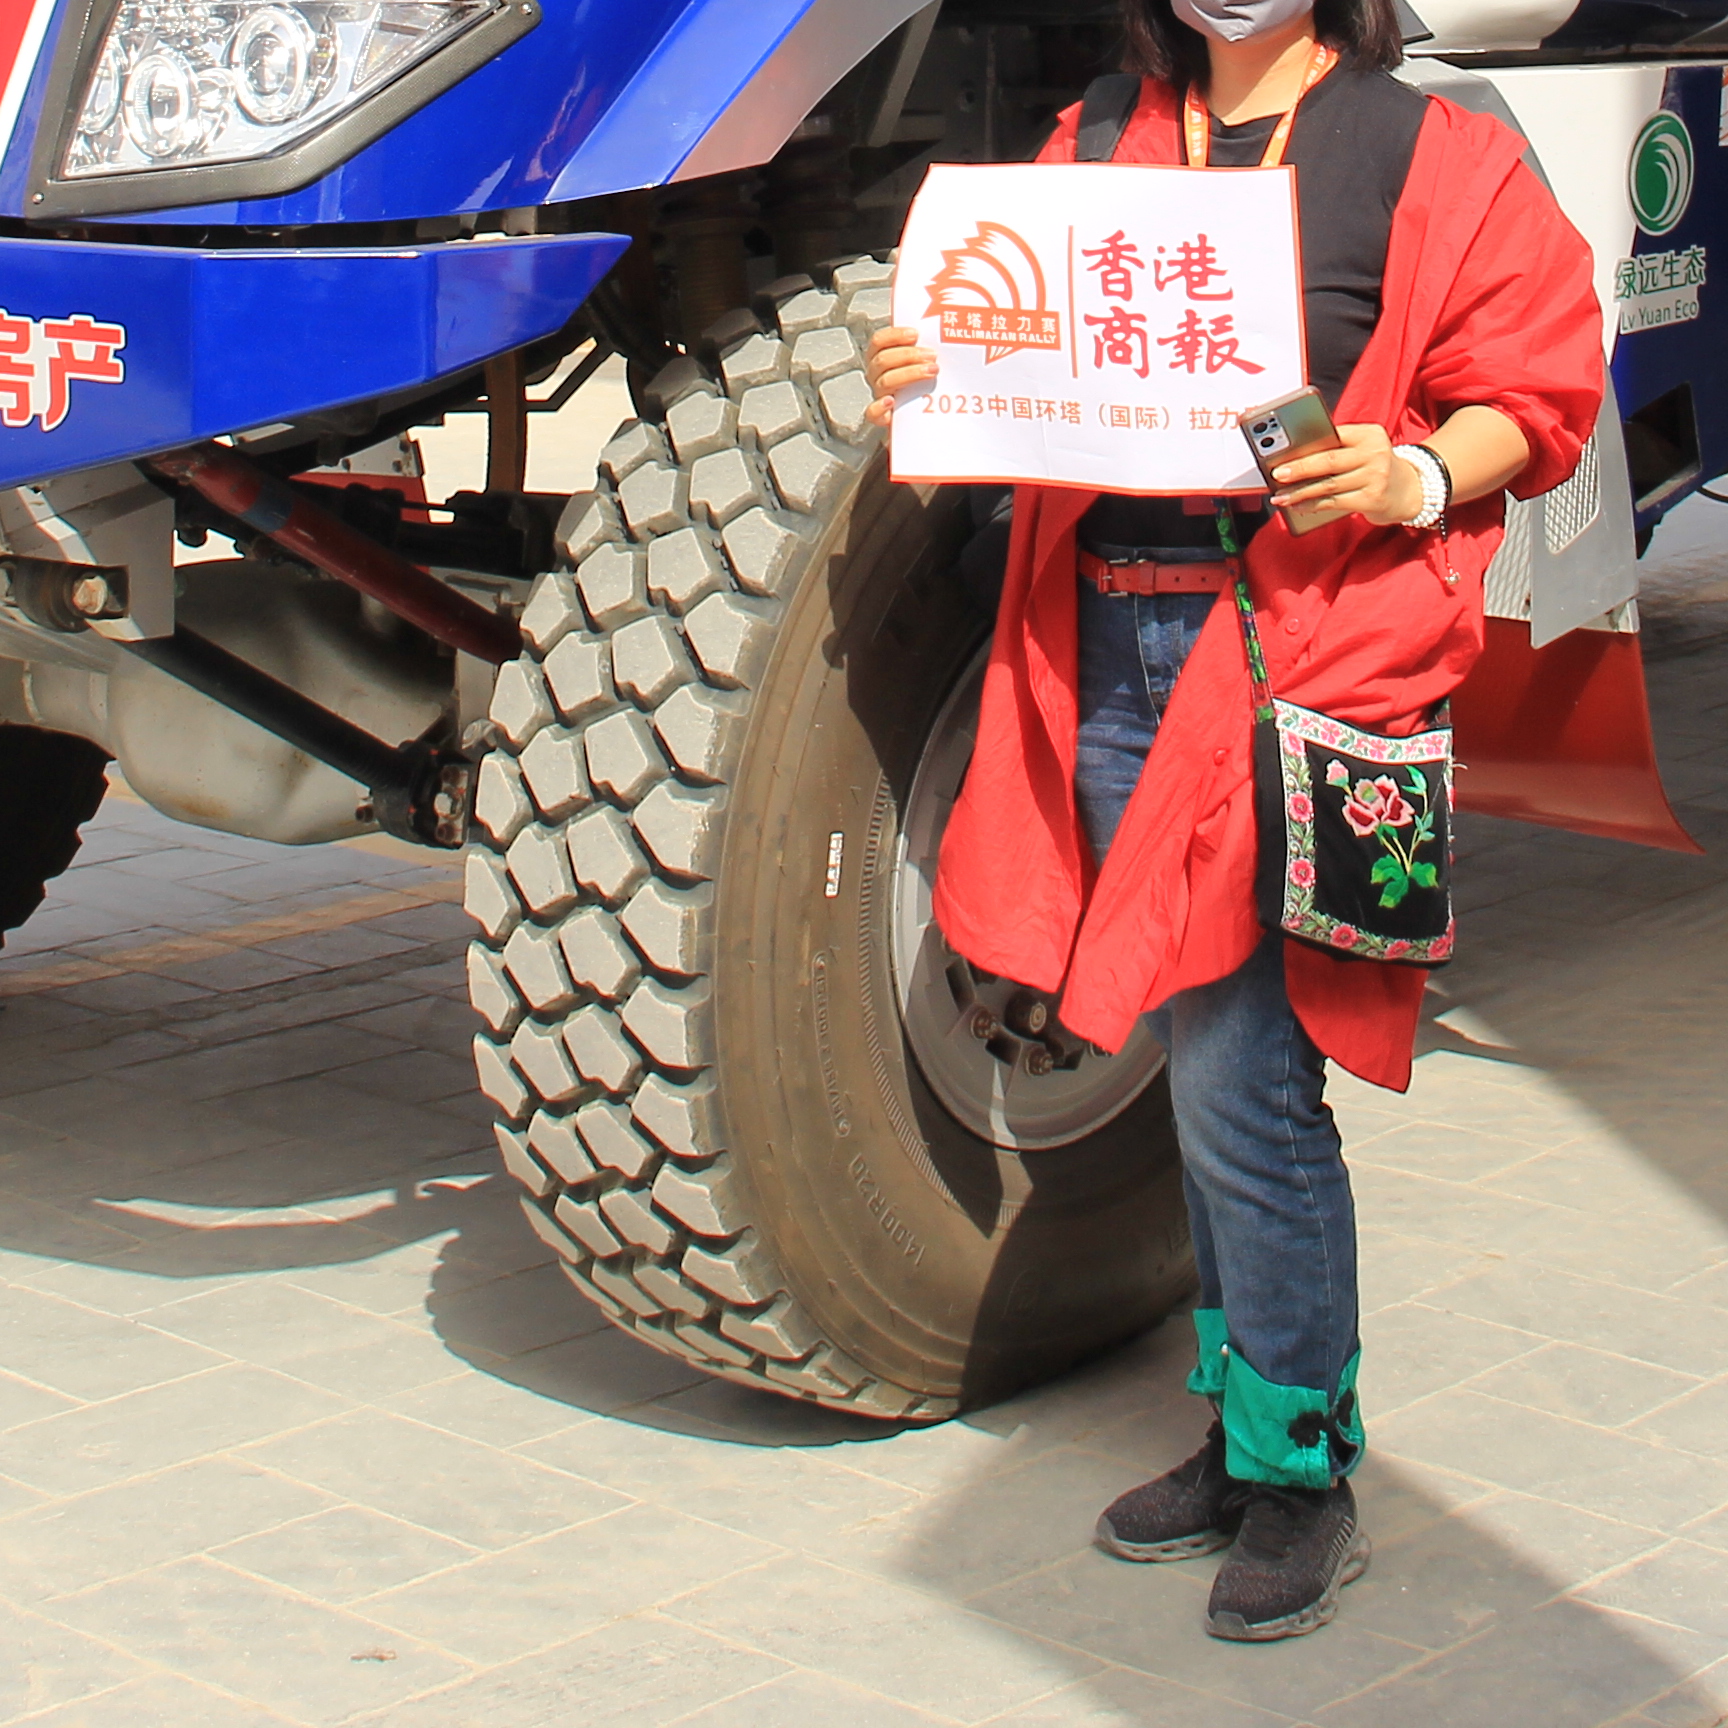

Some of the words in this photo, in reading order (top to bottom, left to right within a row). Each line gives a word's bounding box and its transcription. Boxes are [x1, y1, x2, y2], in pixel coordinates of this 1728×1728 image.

[1081, 228, 1235, 303] 香港
[1613, 245, 1707, 300] 绿远生态
[942, 310, 1057, 334] 环塔拉力赛
[943, 327, 1018, 342] TAKLIMAKAN
[1018, 332, 1058, 345] RALLY
[1620, 310, 1636, 332] Lv
[1638, 304, 1672, 328] Yuan
[1675, 298, 1700, 320] Eco
[1083, 306, 1268, 380] 商報
